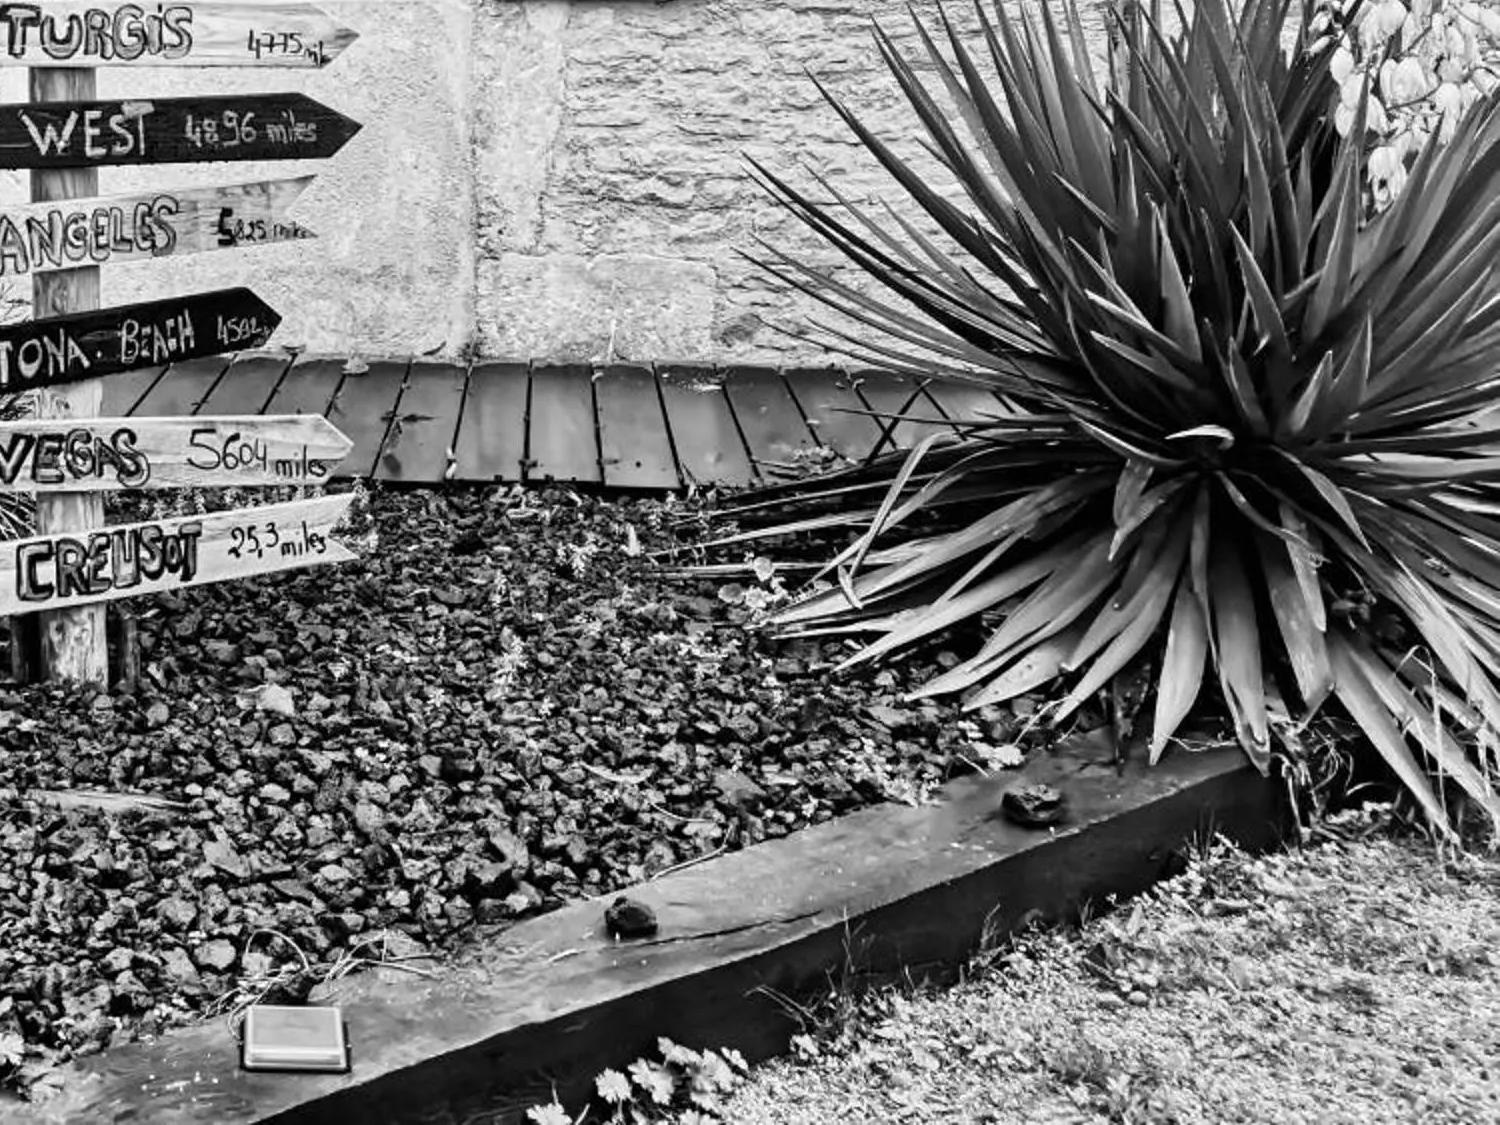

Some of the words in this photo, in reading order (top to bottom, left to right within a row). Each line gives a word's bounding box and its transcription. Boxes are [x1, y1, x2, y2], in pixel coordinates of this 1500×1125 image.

[247, 28, 302, 59] 4775
[17, 101, 155, 158] WEST
[184, 109, 257, 148] 4896
[266, 108, 317, 145] miles
[121, 308, 195, 363] BEACH
[187, 428, 267, 472] 5604
[275, 444, 327, 479] miles
[16, 522, 203, 603] CREUSOT
[228, 522, 279, 558] 25,3
[281, 520, 327, 555] miles
